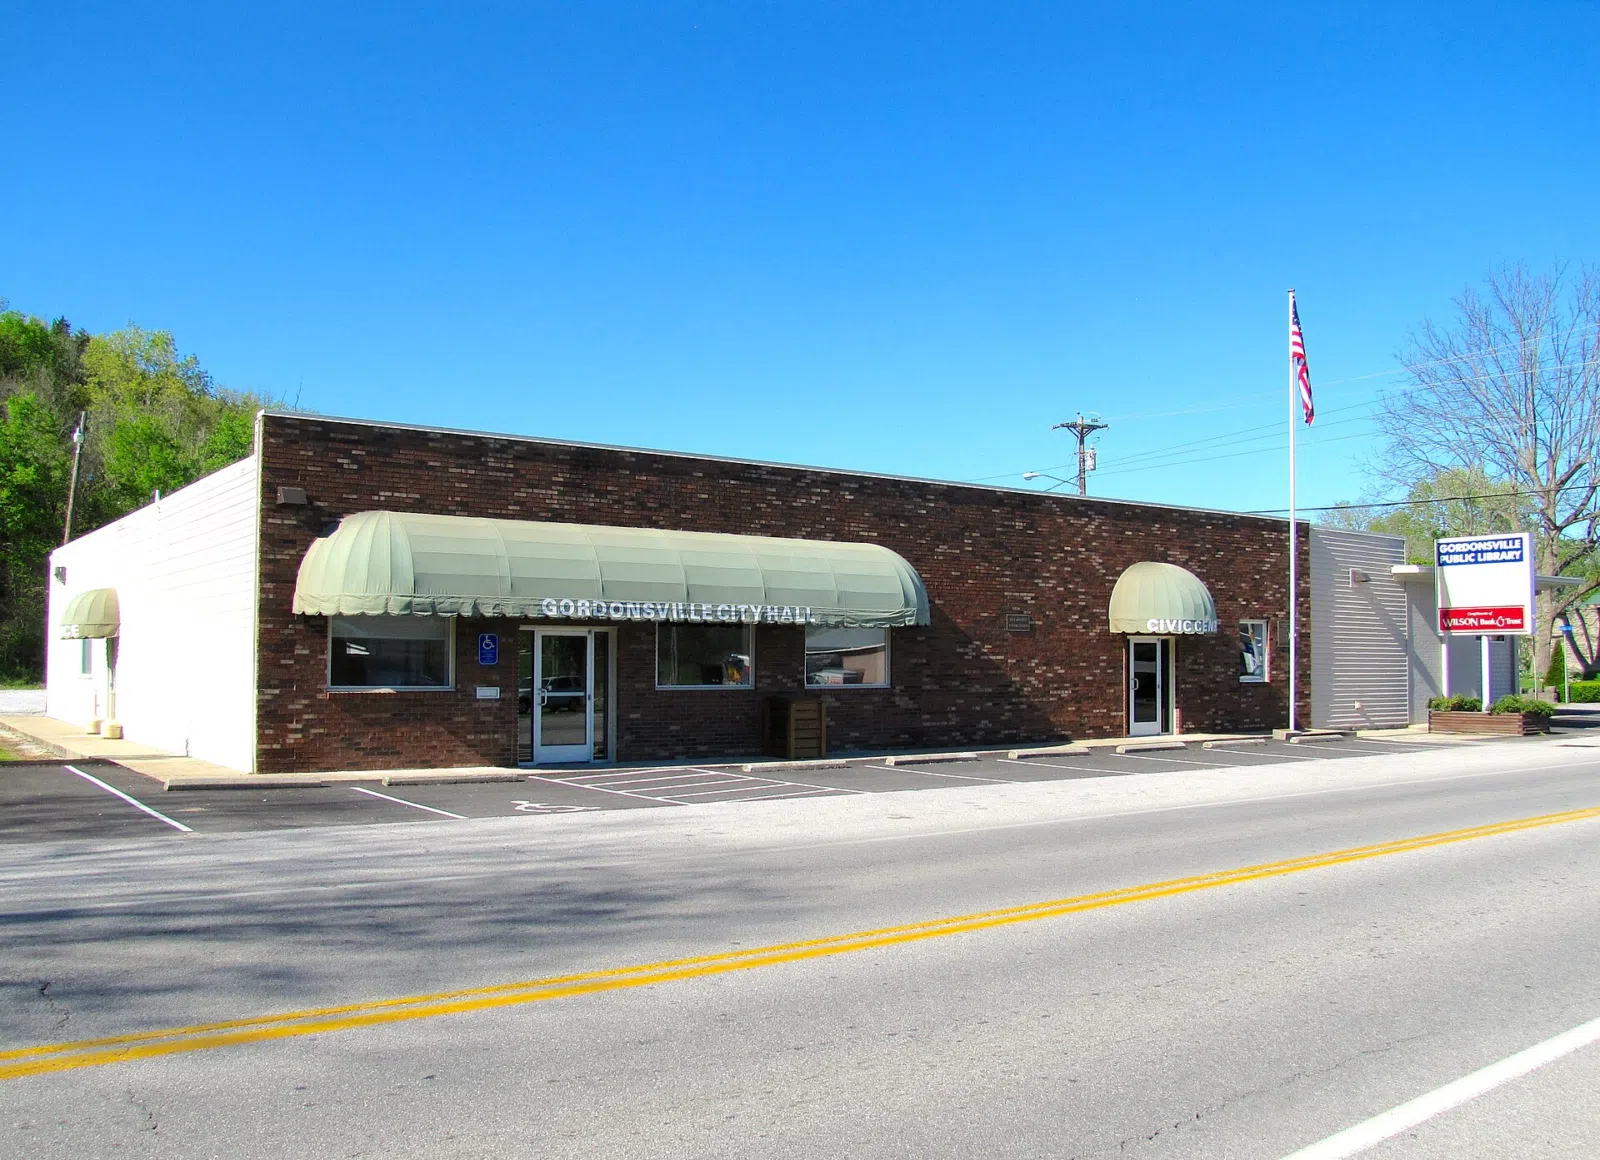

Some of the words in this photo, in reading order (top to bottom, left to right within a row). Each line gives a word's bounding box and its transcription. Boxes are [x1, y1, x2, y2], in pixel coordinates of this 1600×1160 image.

[1440, 539, 1521, 553] GORDONSVILLE
[1440, 553, 1475, 563] PUBLIC
[1478, 550, 1521, 562] LIBRARY
[541, 598, 712, 621] GORDONSVILLE
[717, 603, 761, 621] CITY
[765, 605, 816, 622] HALL
[1146, 618, 1192, 632] CIVIC
[1443, 617, 1478, 627] WILSON
[1504, 617, 1522, 625] Trust
